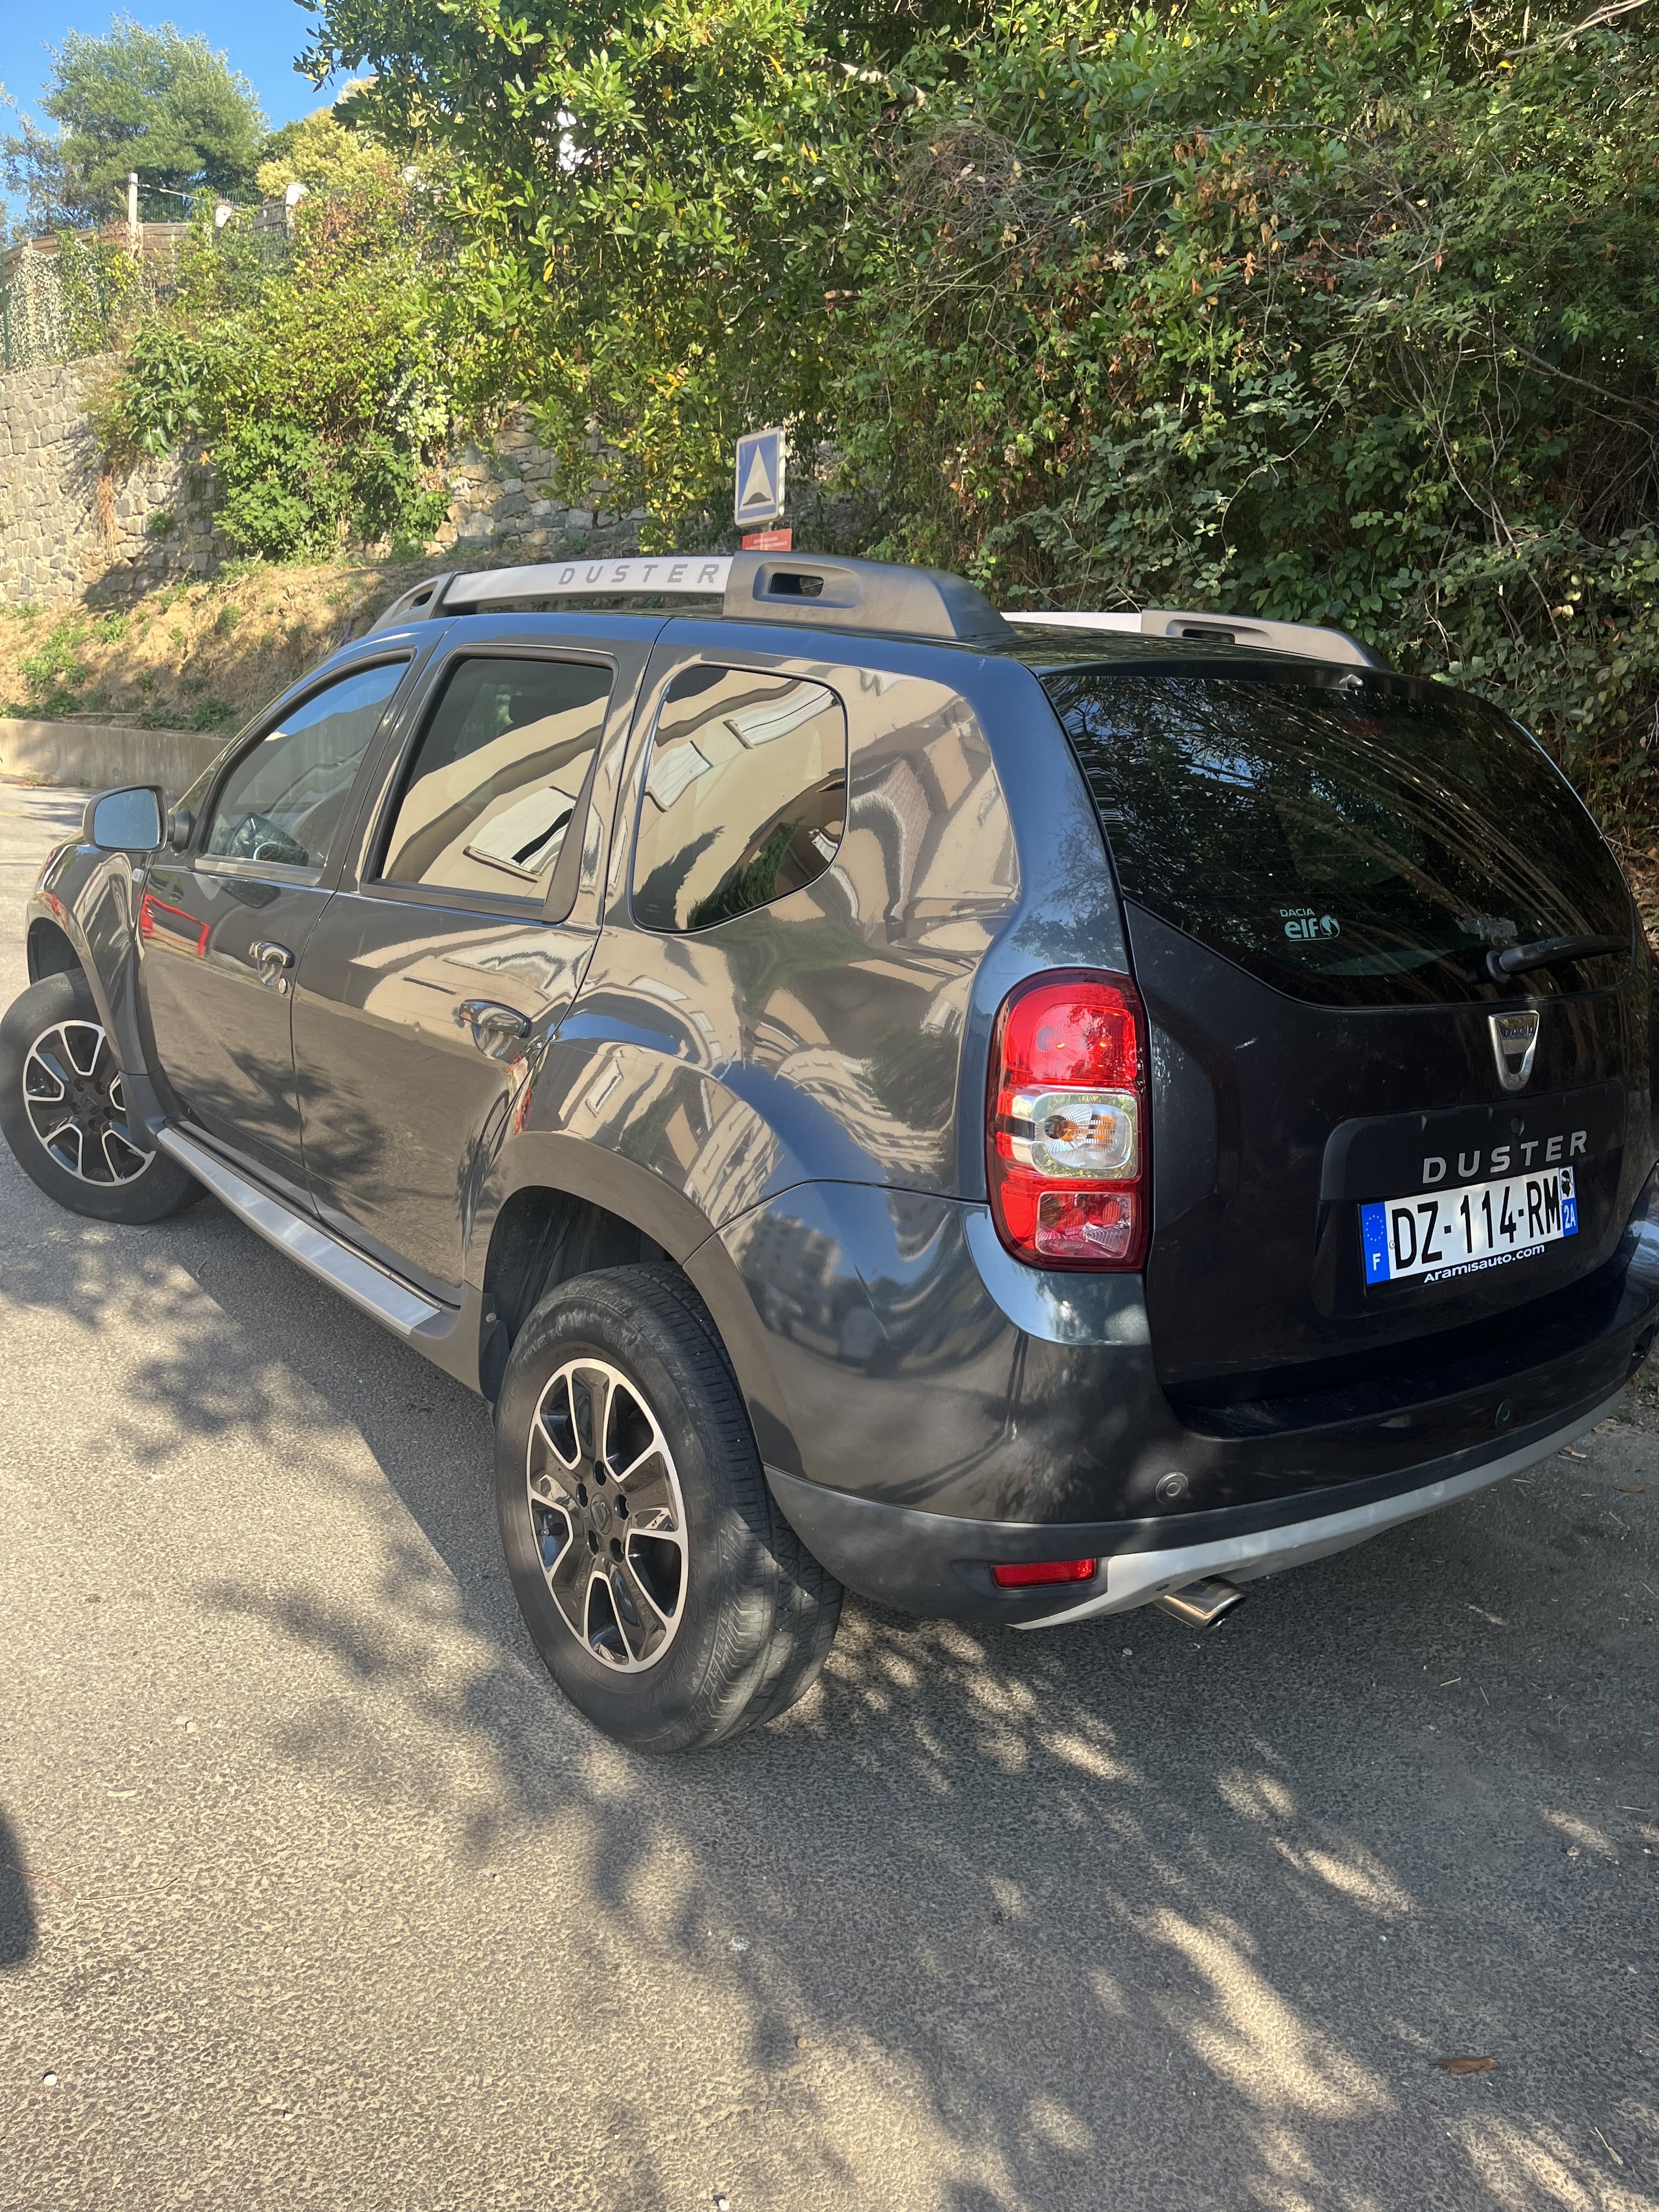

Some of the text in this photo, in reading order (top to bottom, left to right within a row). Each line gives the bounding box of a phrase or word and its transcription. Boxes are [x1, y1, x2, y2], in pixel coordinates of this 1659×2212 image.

[558, 563, 720, 585] DUSTER
[1279, 908, 1315, 917] DACIA
[1284, 918, 1319, 939] elf
[1422, 1130, 1588, 1184] DUSTER
[1391, 1176, 1561, 1271] DZ-114-RM
[1564, 1205, 1576, 1229] 2A
[1372, 1252, 1381, 1271] F
[1424, 1244, 1545, 1284] Aramisauto.com
